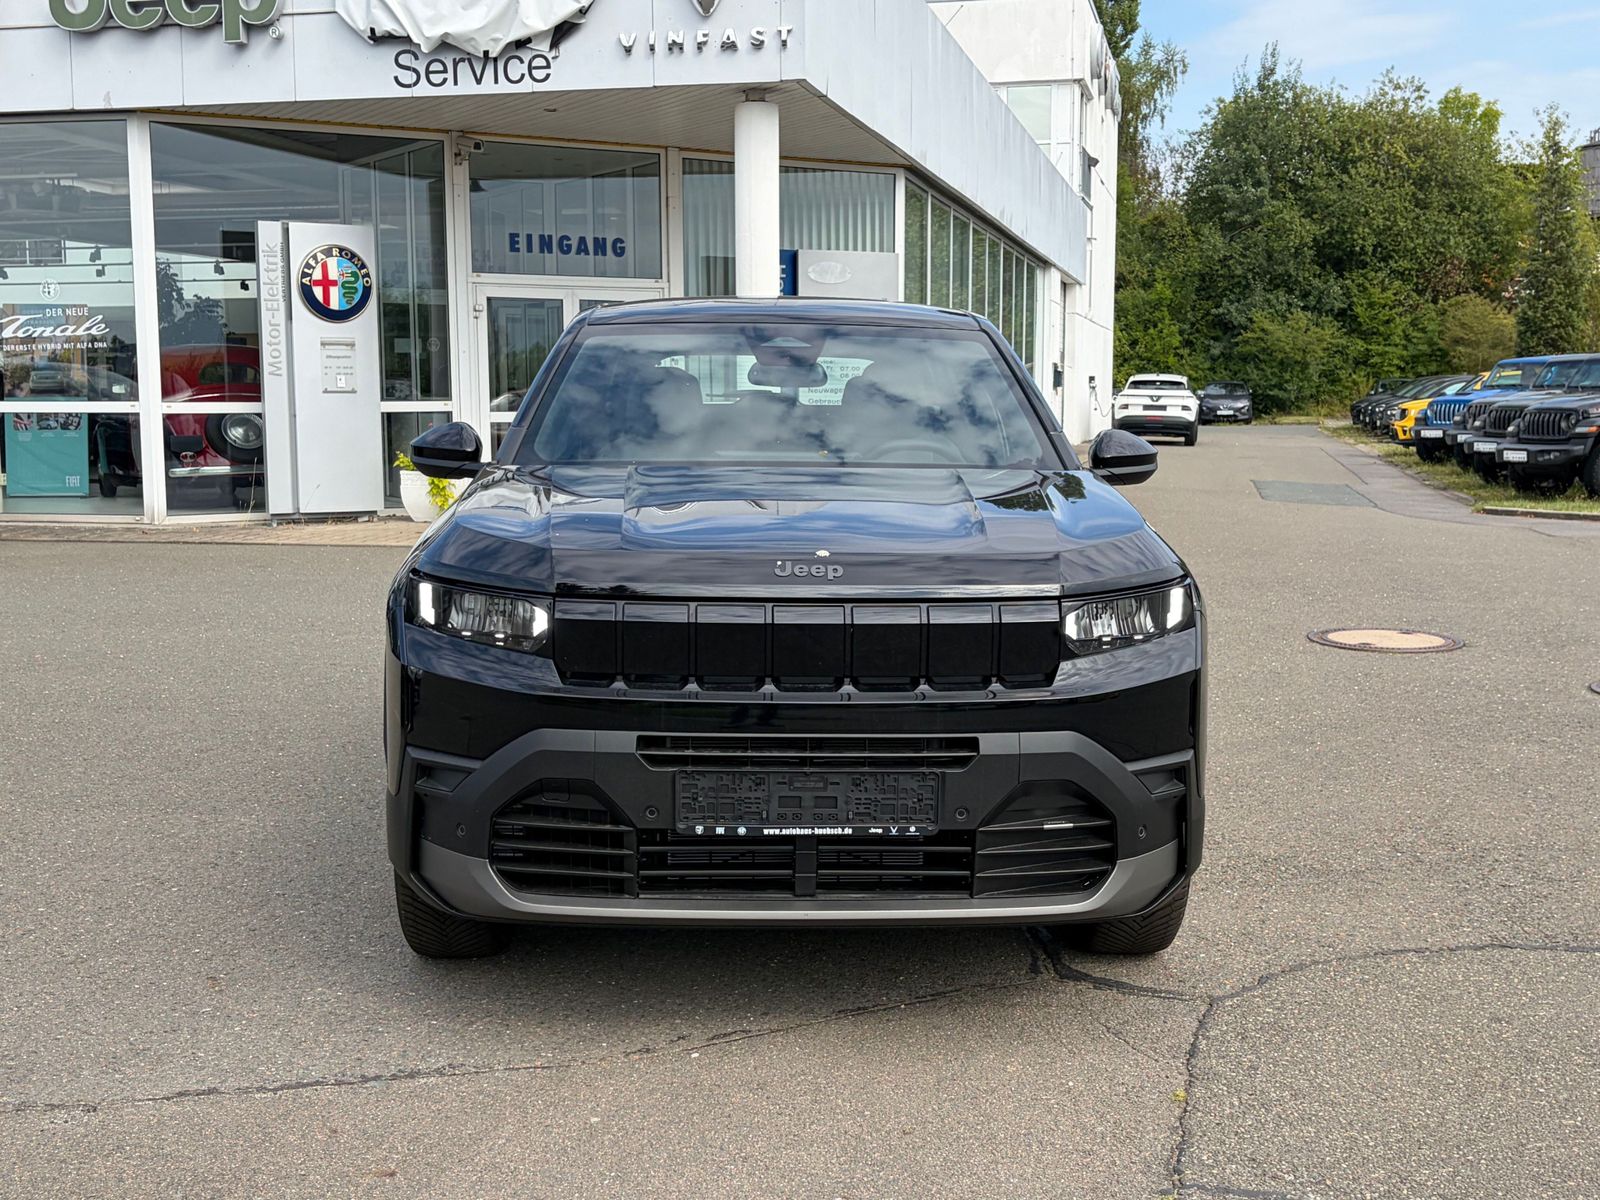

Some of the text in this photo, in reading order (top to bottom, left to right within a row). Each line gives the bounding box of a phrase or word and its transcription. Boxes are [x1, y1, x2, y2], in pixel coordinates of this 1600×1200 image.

[618, 25, 793, 54] VINFAST
[393, 49, 552, 88] Service
[508, 232, 626, 258] EINGANG
[302, 251, 326, 286] ALFA
[332, 247, 371, 286] ROMEO
[45, 307, 89, 317] DER NEUE
[261, 242, 283, 377] Motor-Elektrik
[0, 314, 110, 338] Tonale
[38, 342, 62, 350] HYBRID
[65, 475, 80, 487] FIAT
[774, 561, 844, 581] Jeep
